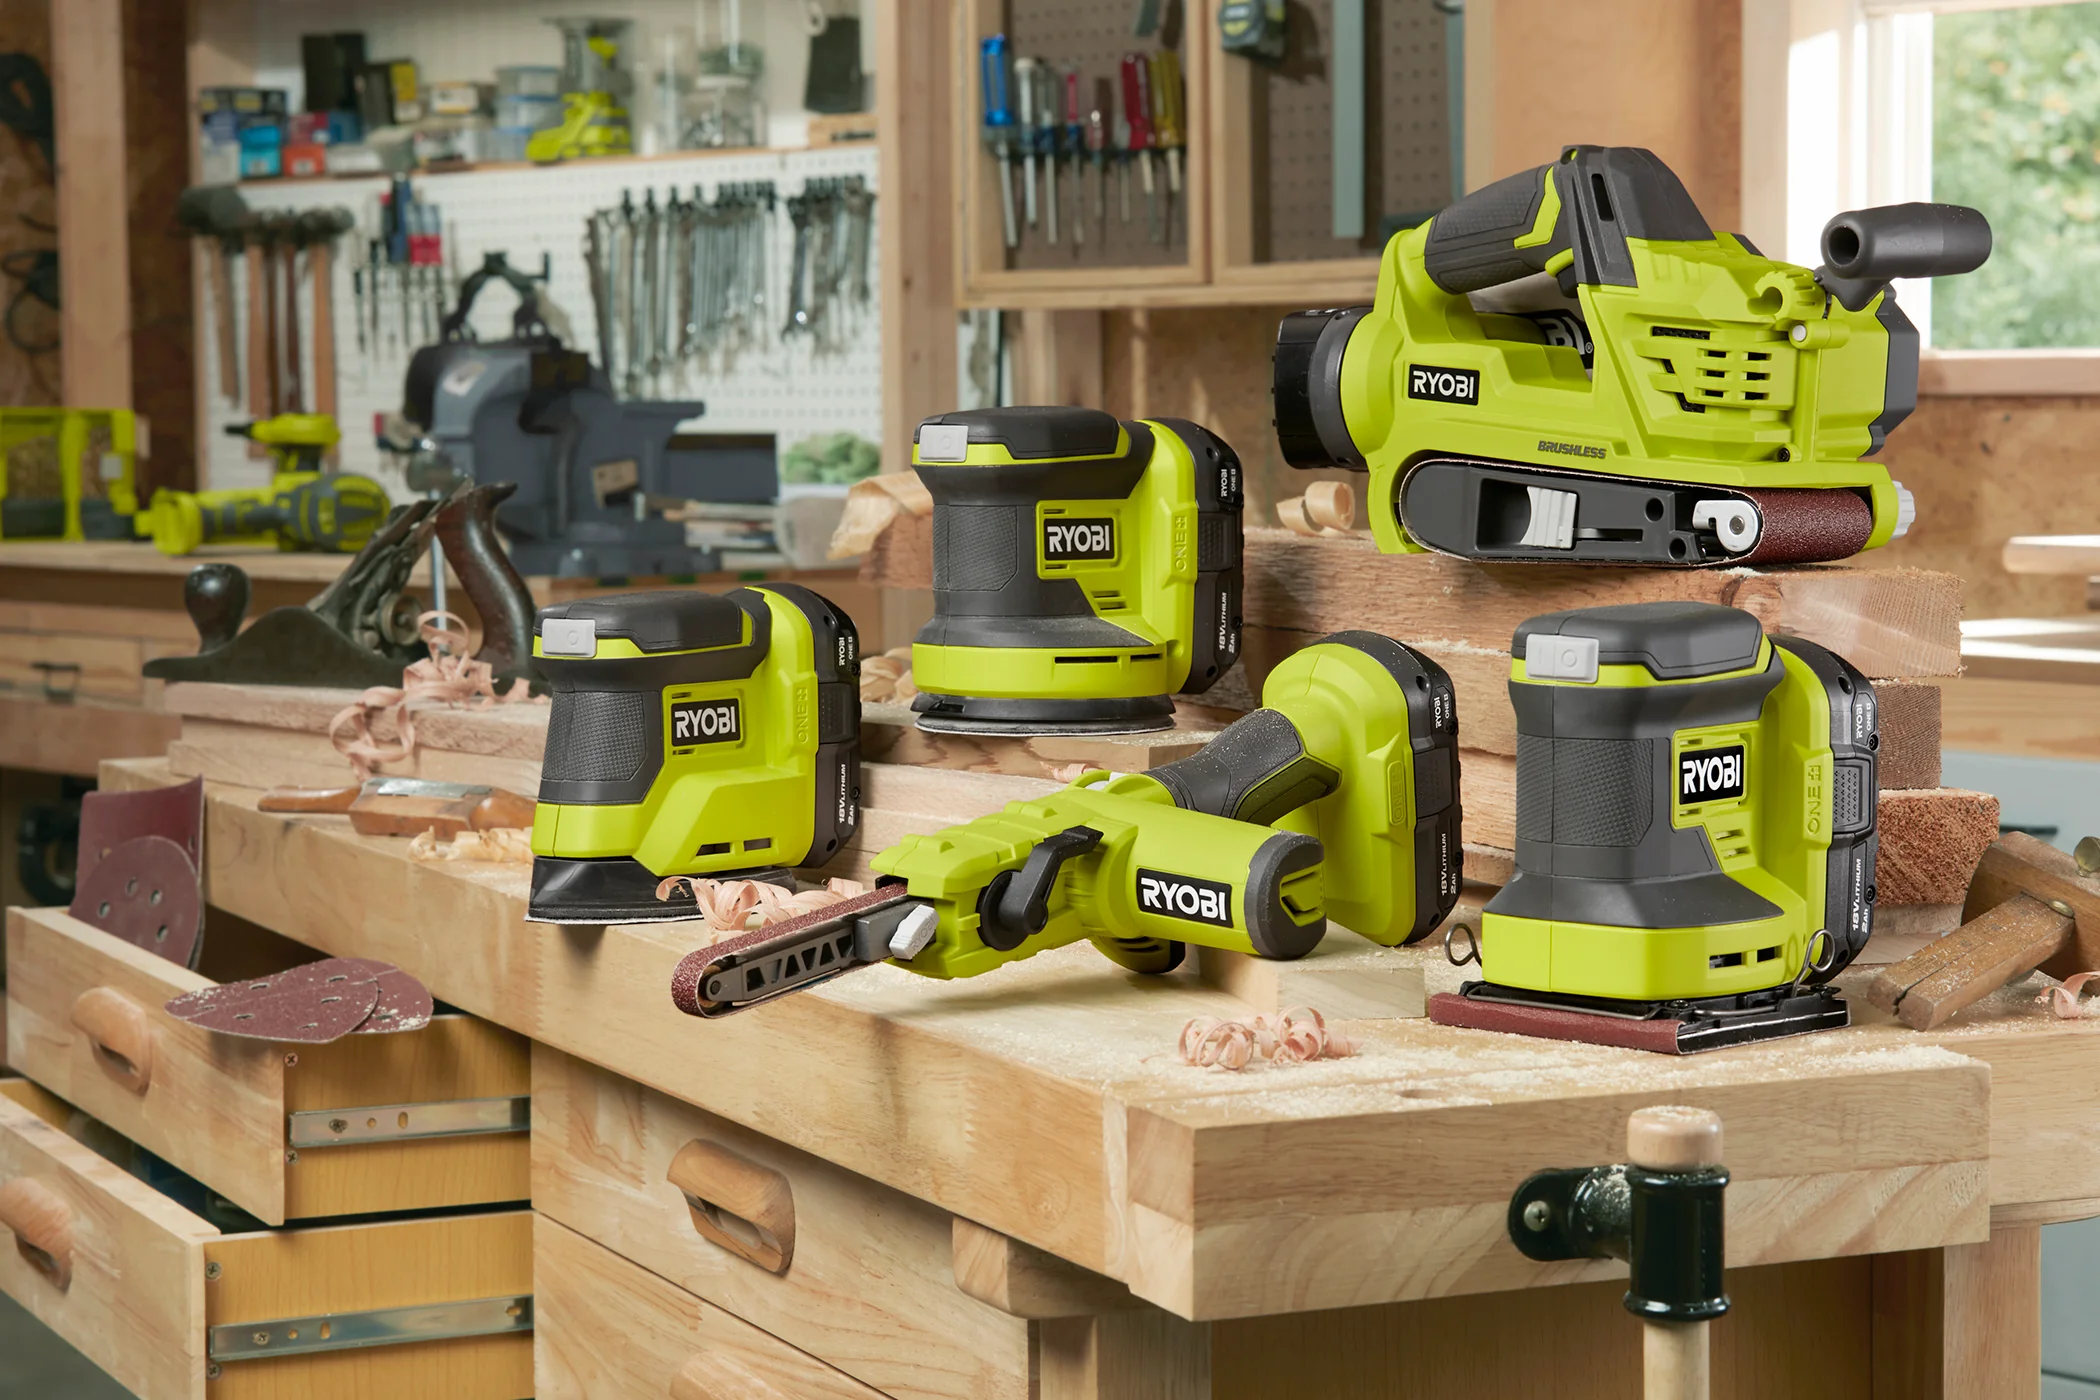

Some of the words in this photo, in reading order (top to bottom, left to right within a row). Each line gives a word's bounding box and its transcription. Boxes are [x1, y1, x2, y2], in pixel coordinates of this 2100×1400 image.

[1413, 370, 1475, 399] RYOBI
[1537, 440, 1607, 459] BRUSHLESS
[1220, 468, 1228, 497] RYOBI
[1047, 524, 1110, 552] RYOBI
[838, 636, 846, 667] RYOBI
[674, 705, 736, 739] RYOBI
[1433, 696, 1442, 729] RYOBI
[1855, 703, 1863, 739] RYOBI
[1682, 753, 1741, 795] RYOBI
[1140, 876, 1227, 921] RYOBI
